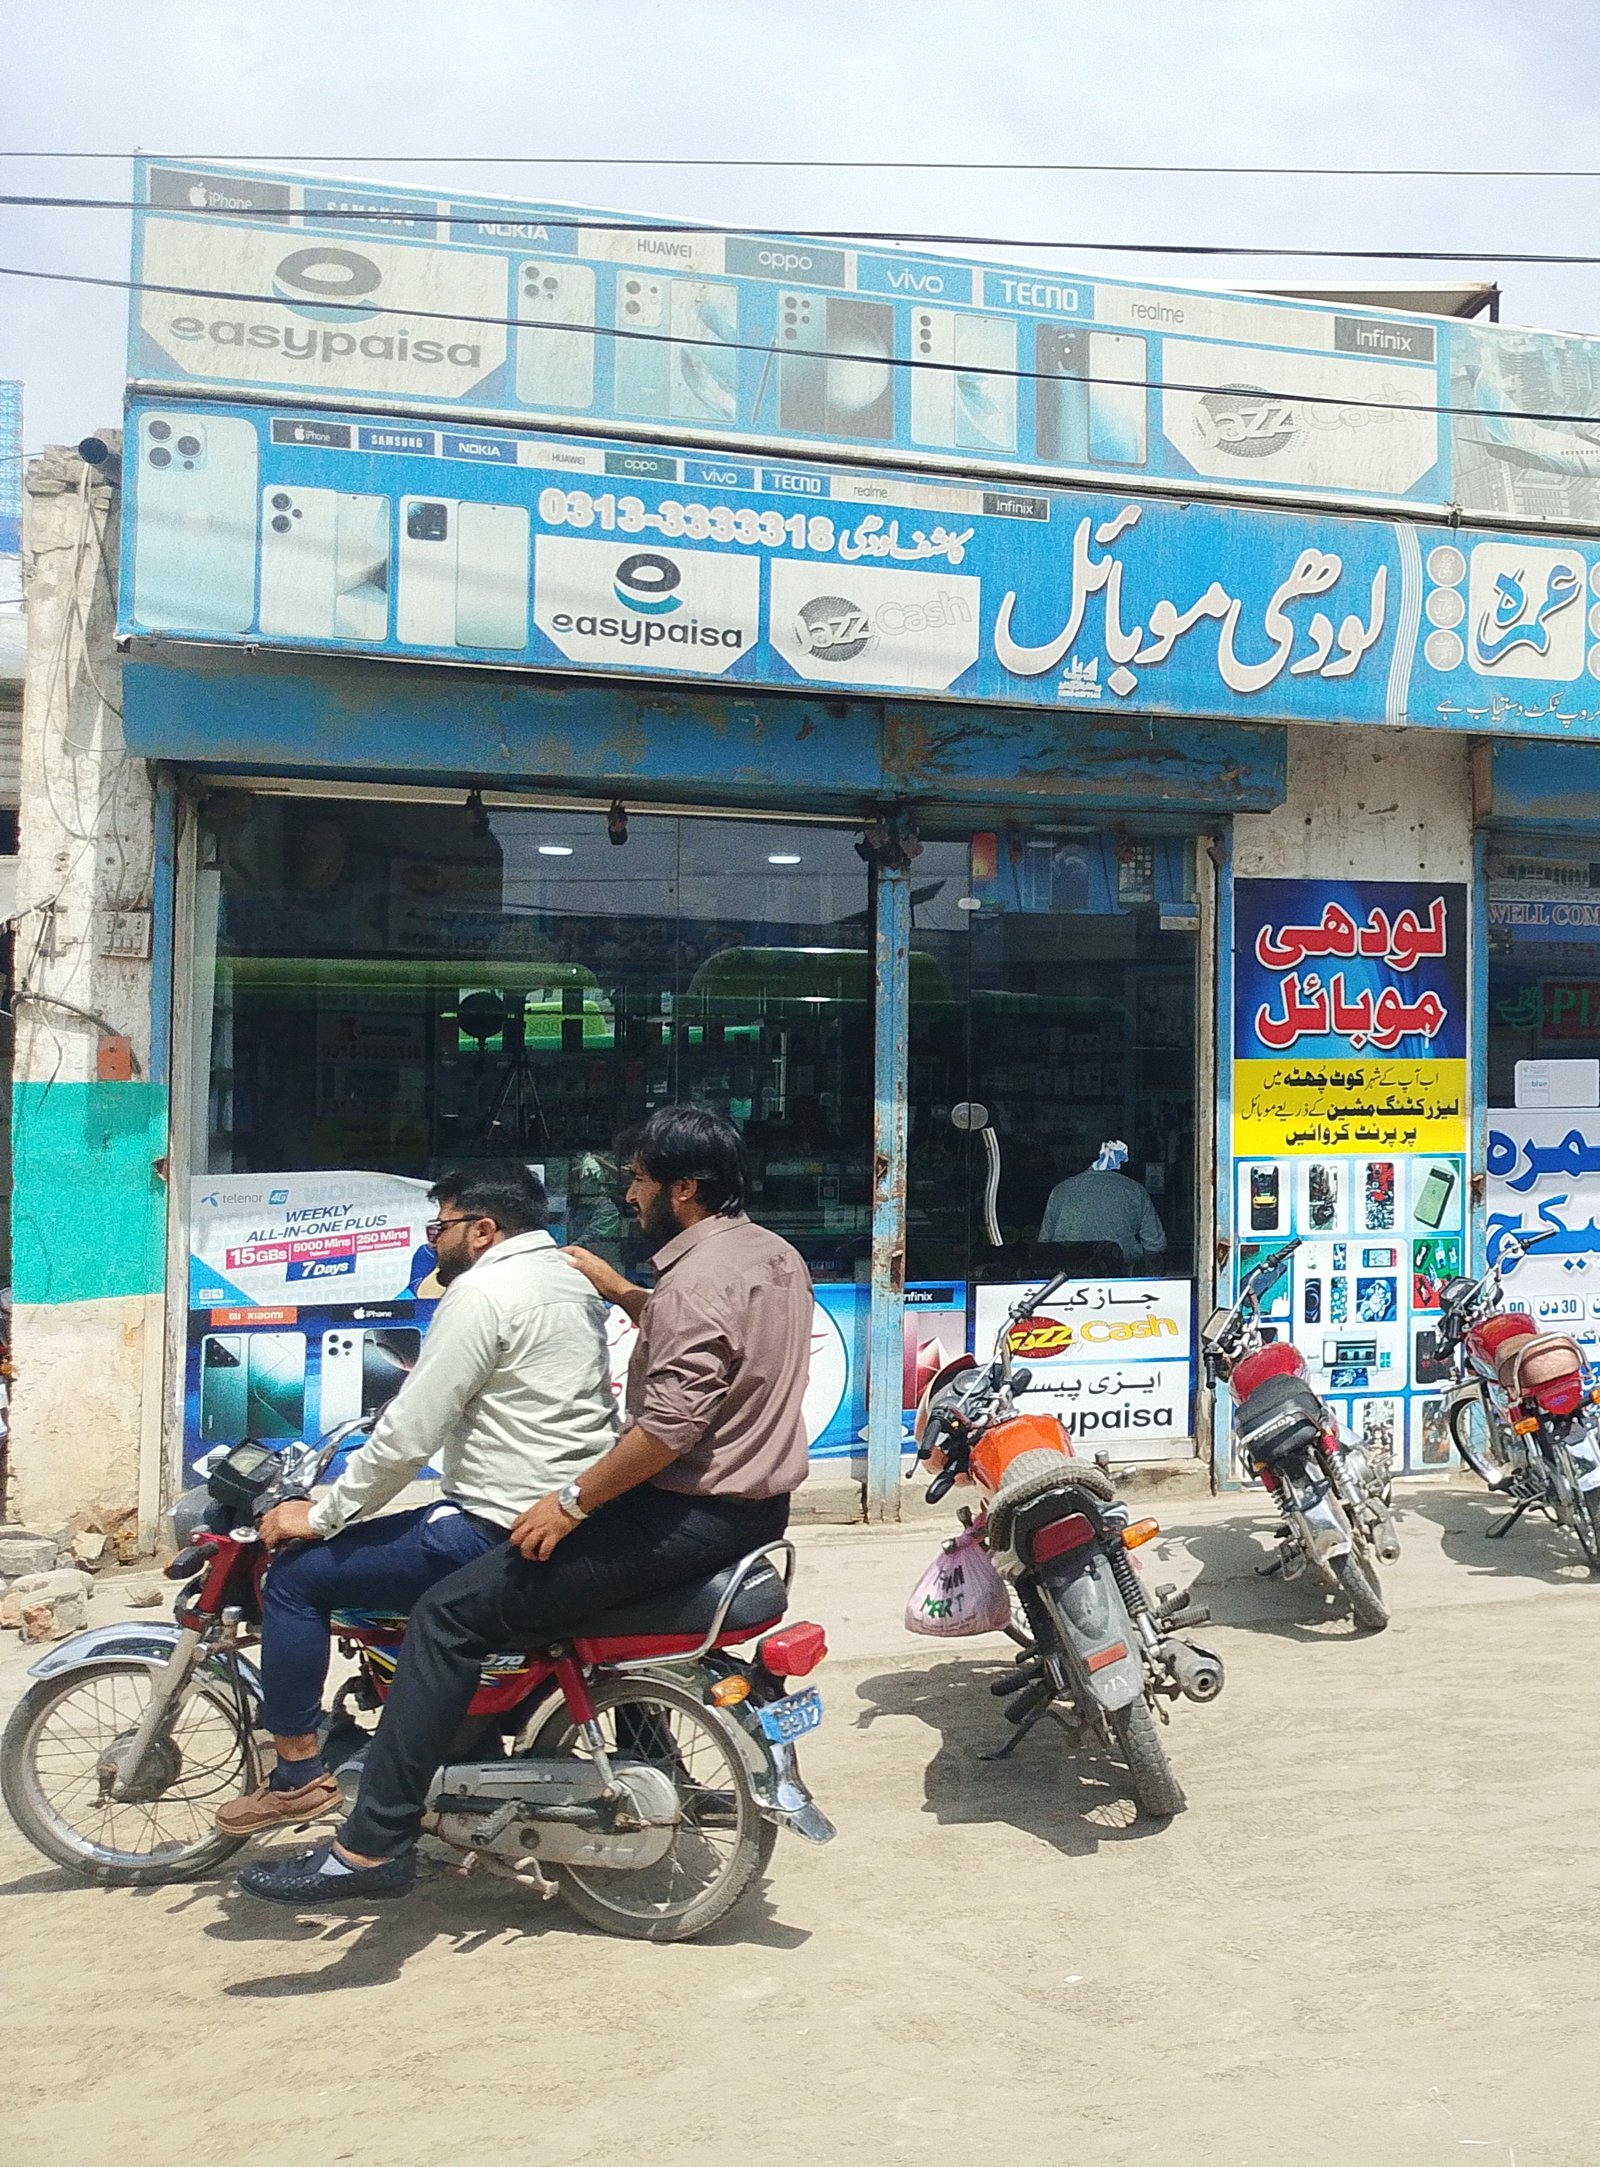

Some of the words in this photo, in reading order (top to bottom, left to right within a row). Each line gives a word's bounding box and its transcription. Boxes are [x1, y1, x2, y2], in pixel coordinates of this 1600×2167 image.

[208, 192, 253, 212] iPhone
[477, 221, 549, 242] NOKIA
[636, 238, 693, 260] HUAWEI
[758, 250, 813, 272] oppo
[887, 268, 945, 295] vivo
[1000, 279, 1079, 312] TECNO
[1130, 301, 1186, 325] realme
[168, 315, 482, 369] easypaisa
[1356, 327, 1413, 353] Infinix
[305, 429, 332, 444] iPhone
[371, 433, 424, 450] SAMSUNG
[458, 442, 501, 458] NOKIA
[551, 451, 586, 466] HUAWEI
[624, 457, 658, 474] oppo
[702, 468, 738, 485] vivo
[771, 473, 822, 495] TECNO
[854, 484, 889, 500] realme
[996, 499, 1035, 517] Infinix
[538, 487, 836, 552] 0313-3333318
[993, 503, 1237, 698] موبائل
[1217, 547, 1389, 694] لودھی
[1476, 563, 1583, 665] عمرہ
[551, 612, 744, 650] easypaisa
[1555, 707, 1600, 729] روپ
[1488, 903, 1550, 925] WELL
[1552, 904, 1600, 927] COM
[1255, 895, 1448, 972] لودھی
[1254, 971, 1449, 1050] موبائل
[1553, 987, 1600, 1026] PI
[1486, 1129, 1600, 1193] مرہ
[222, 1192, 264, 1204] telenor
[285, 1204, 354, 1224] WEEKLY
[246, 1219, 344, 1243] ALL-IN-ONE
[344, 1214, 388, 1231] PLUS
[356, 1233, 378, 1245] 250
[379, 1229, 409, 1242] Mins
[293, 1240, 323, 1254] 5000
[324, 1236, 352, 1249] Mins
[301, 1260, 315, 1278] 7
[314, 1261, 350, 1277] Days
[904, 1290, 934, 1303] nfinix
[1562, 1299, 1578, 1314] 30
[247, 1311, 284, 1321] xiaomi
[365, 1310, 393, 1319] iPhone
[1539, 1301, 1559, 1317] دن
[1080, 1313, 1180, 1344] Cash
[1024, 1377, 1083, 1402] پیس
[1088, 1370, 1162, 1396] ایزی
[1046, 1402, 1174, 1438] ypaisa
